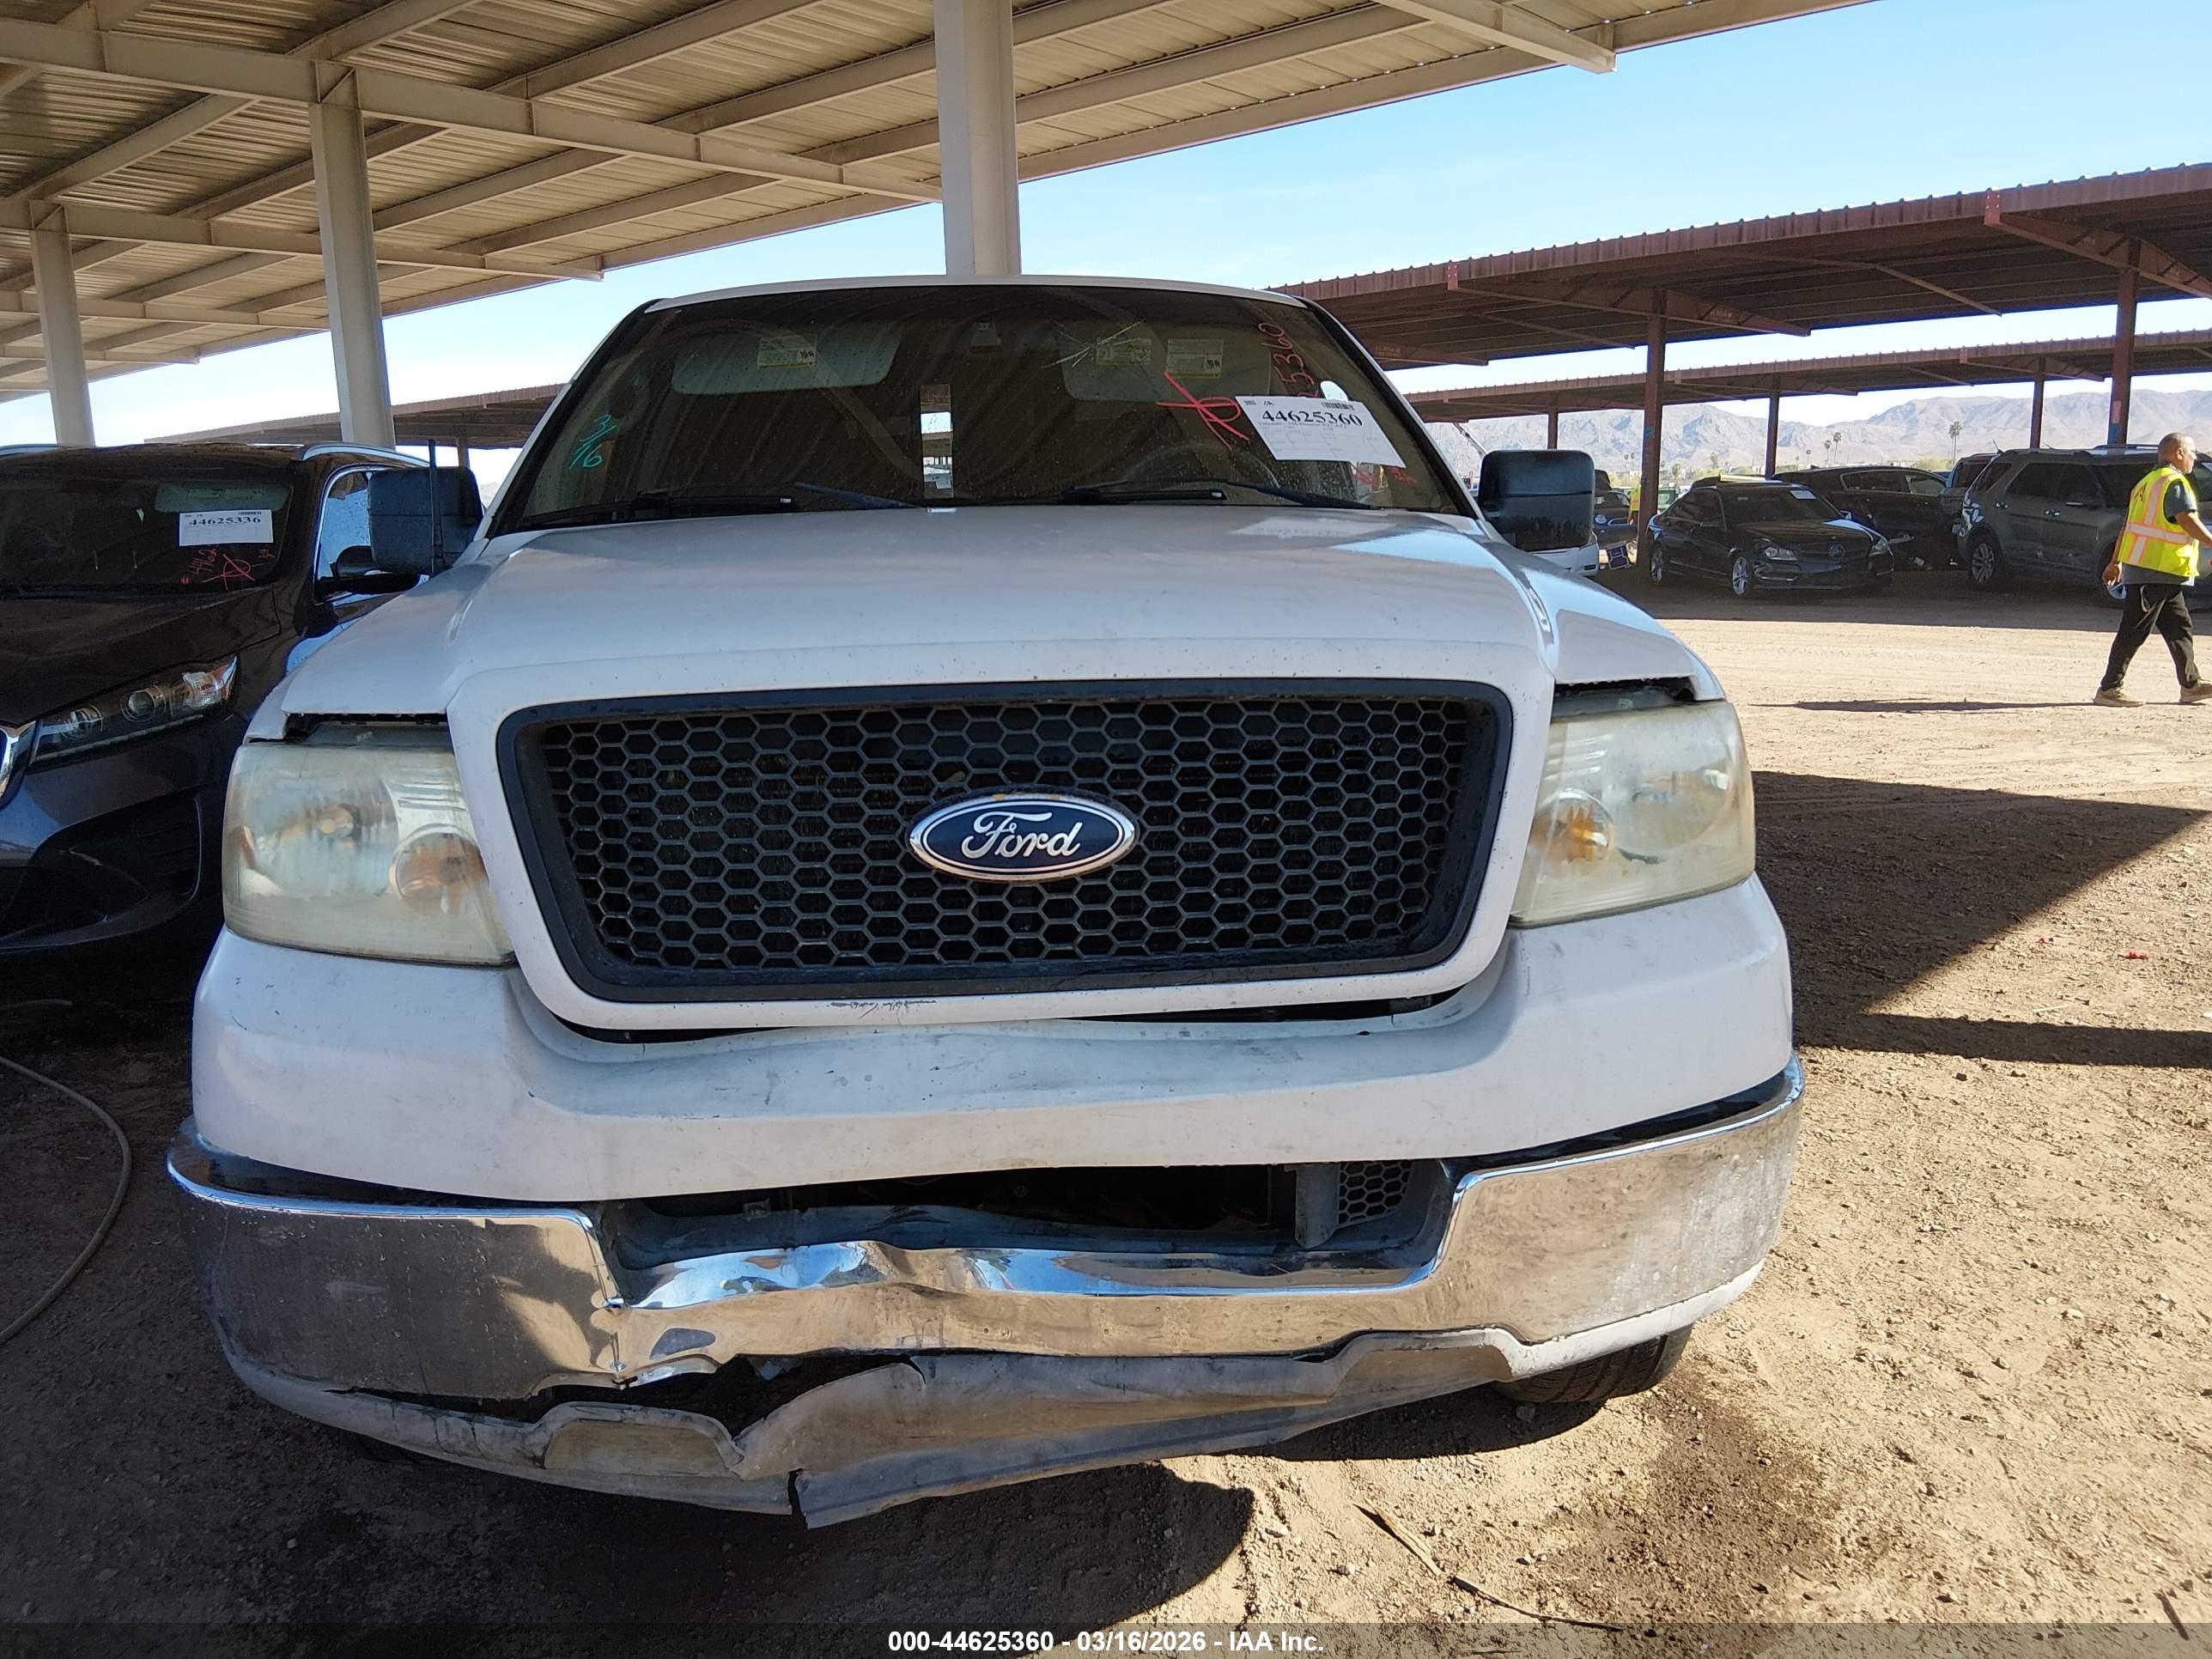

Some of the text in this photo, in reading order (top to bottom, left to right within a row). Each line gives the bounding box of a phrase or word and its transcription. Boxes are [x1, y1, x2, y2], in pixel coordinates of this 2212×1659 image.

[1262, 410, 1363, 427] 44625360
[189, 516, 261, 526] 44625336
[961, 811, 1083, 859] Ford
